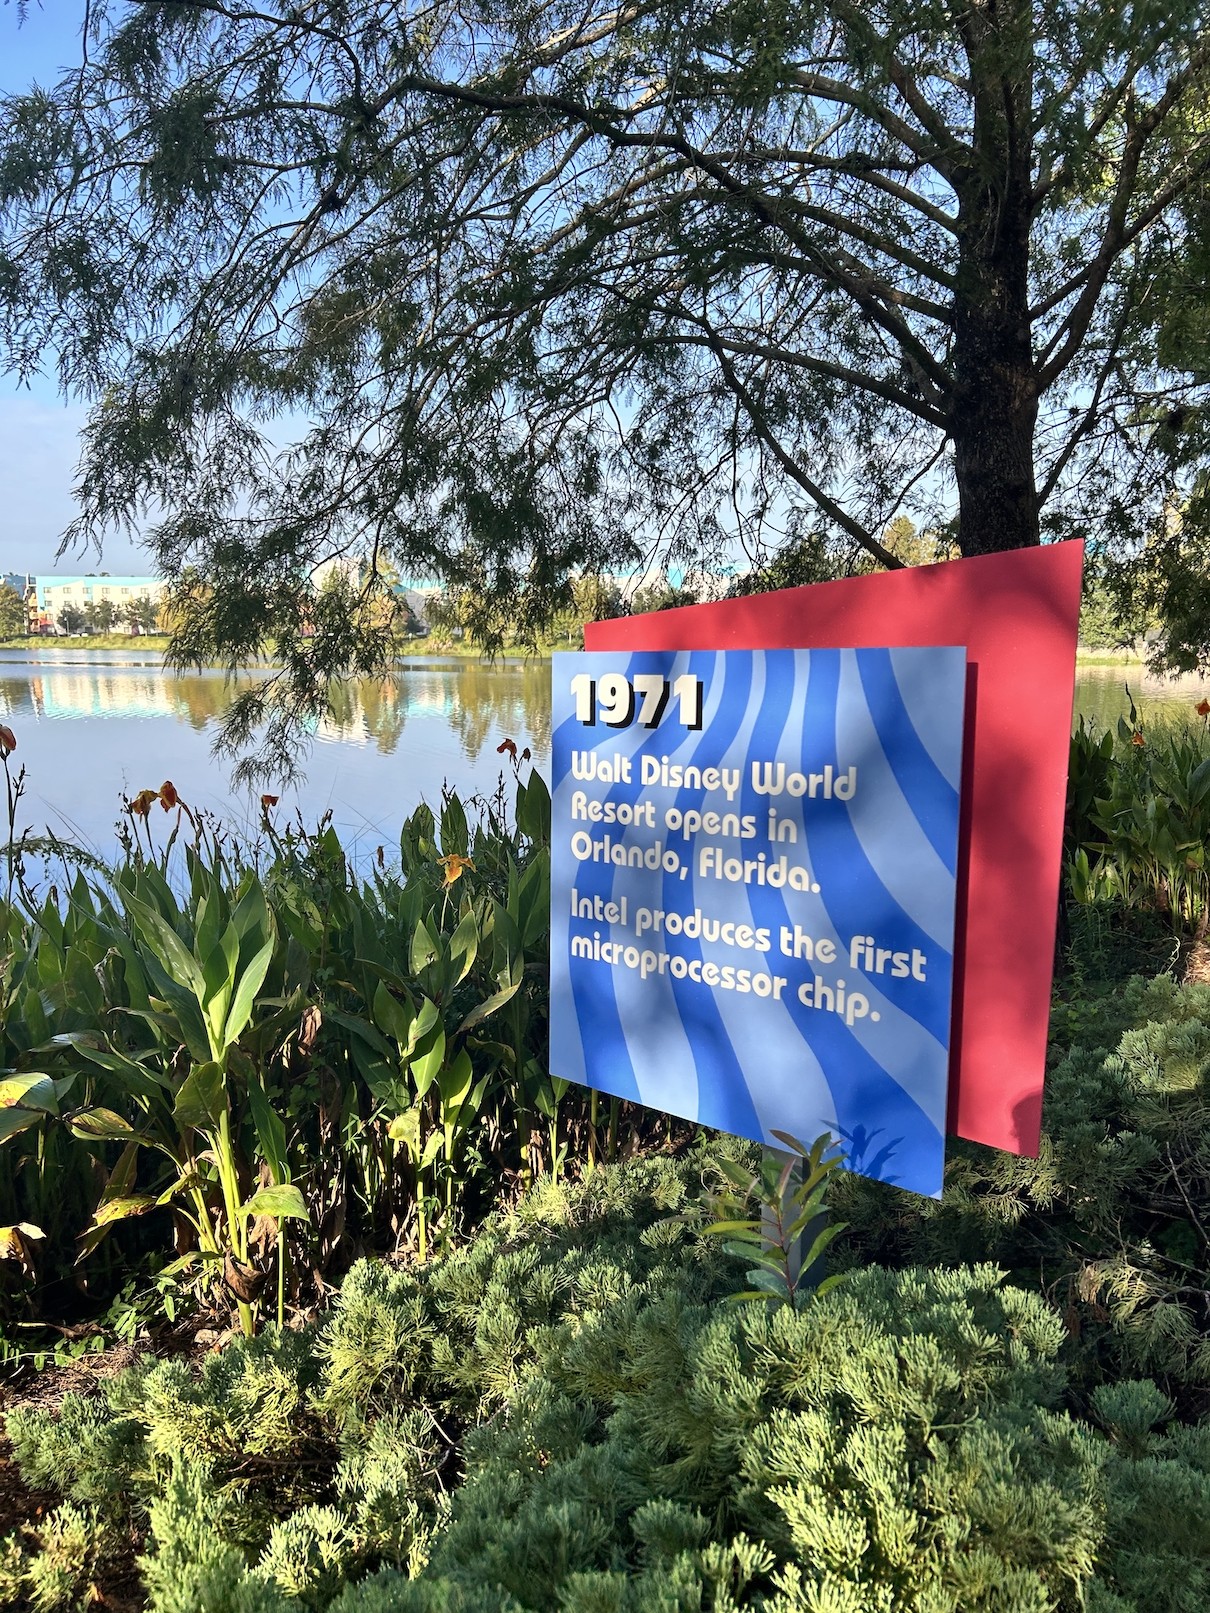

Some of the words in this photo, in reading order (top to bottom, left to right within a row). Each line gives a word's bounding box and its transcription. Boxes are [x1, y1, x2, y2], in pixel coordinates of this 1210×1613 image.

[570, 673, 703, 731] 1971
[571, 751, 632, 784] Walt
[641, 755, 740, 801] Disney
[751, 761, 856, 801] World
[571, 791, 656, 828] Resort
[665, 807, 757, 840] opens
[768, 808, 797, 844] in
[571, 831, 689, 881] Orlando,
[699, 847, 821, 894] Florida.
[571, 889, 627, 926] Intel
[636, 907, 771, 953] produces
[780, 925, 837, 964] the
[850, 936, 927, 982] first
[571, 932, 788, 1000] microprocessor
[797, 977, 881, 1026] chip.
